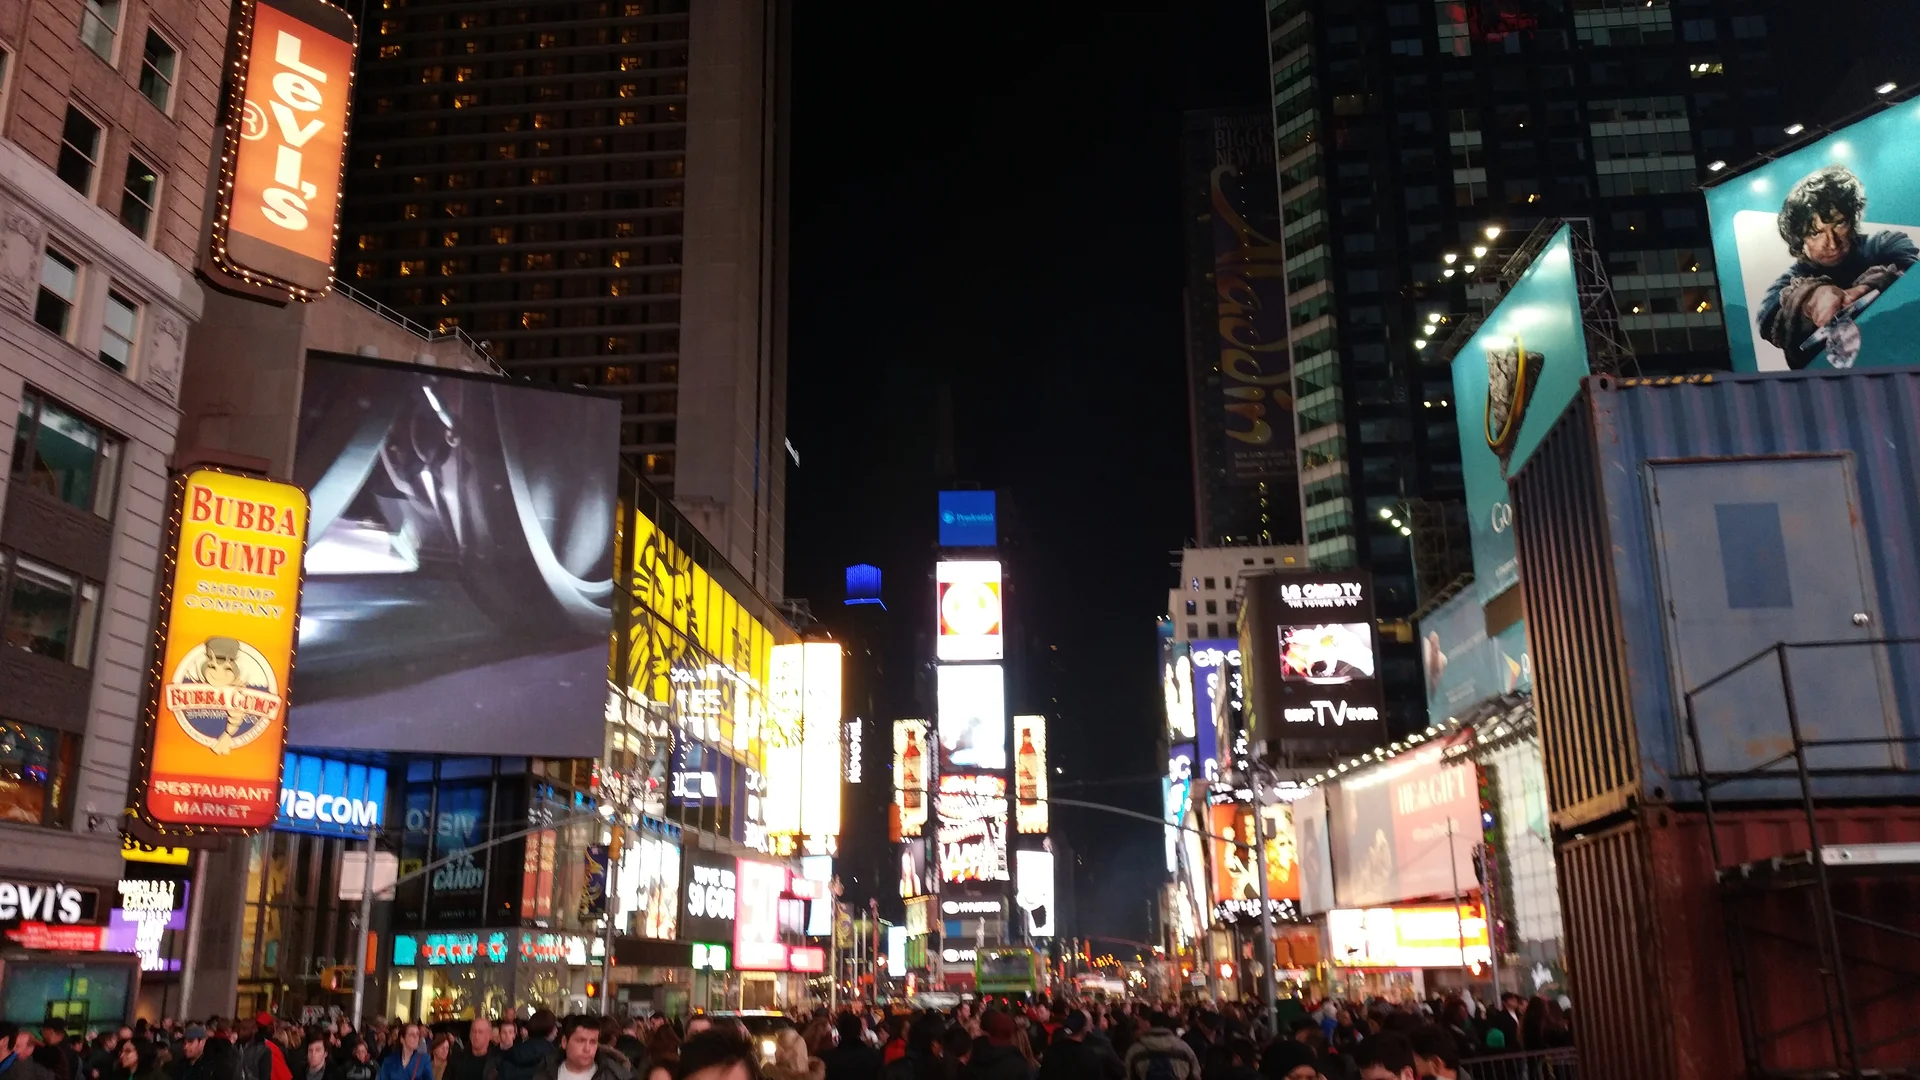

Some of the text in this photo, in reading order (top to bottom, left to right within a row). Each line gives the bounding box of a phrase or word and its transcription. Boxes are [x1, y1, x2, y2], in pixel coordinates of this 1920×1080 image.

[260, 29, 327, 231] Levi's
[1214, 127, 1274, 148] BIGGES
[1215, 146, 1251, 167] NEW
[190, 485, 297, 537] BUBBA
[193, 531, 287, 578] GUMP
[197, 580, 276, 601] SHRIMP
[1341, 582, 1362, 597] TV
[184, 594, 285, 619] COMPANY
[1310, 700, 1348, 726] TV
[153, 781, 273, 802] RESTAURANT
[173, 799, 251, 820] MARKET
